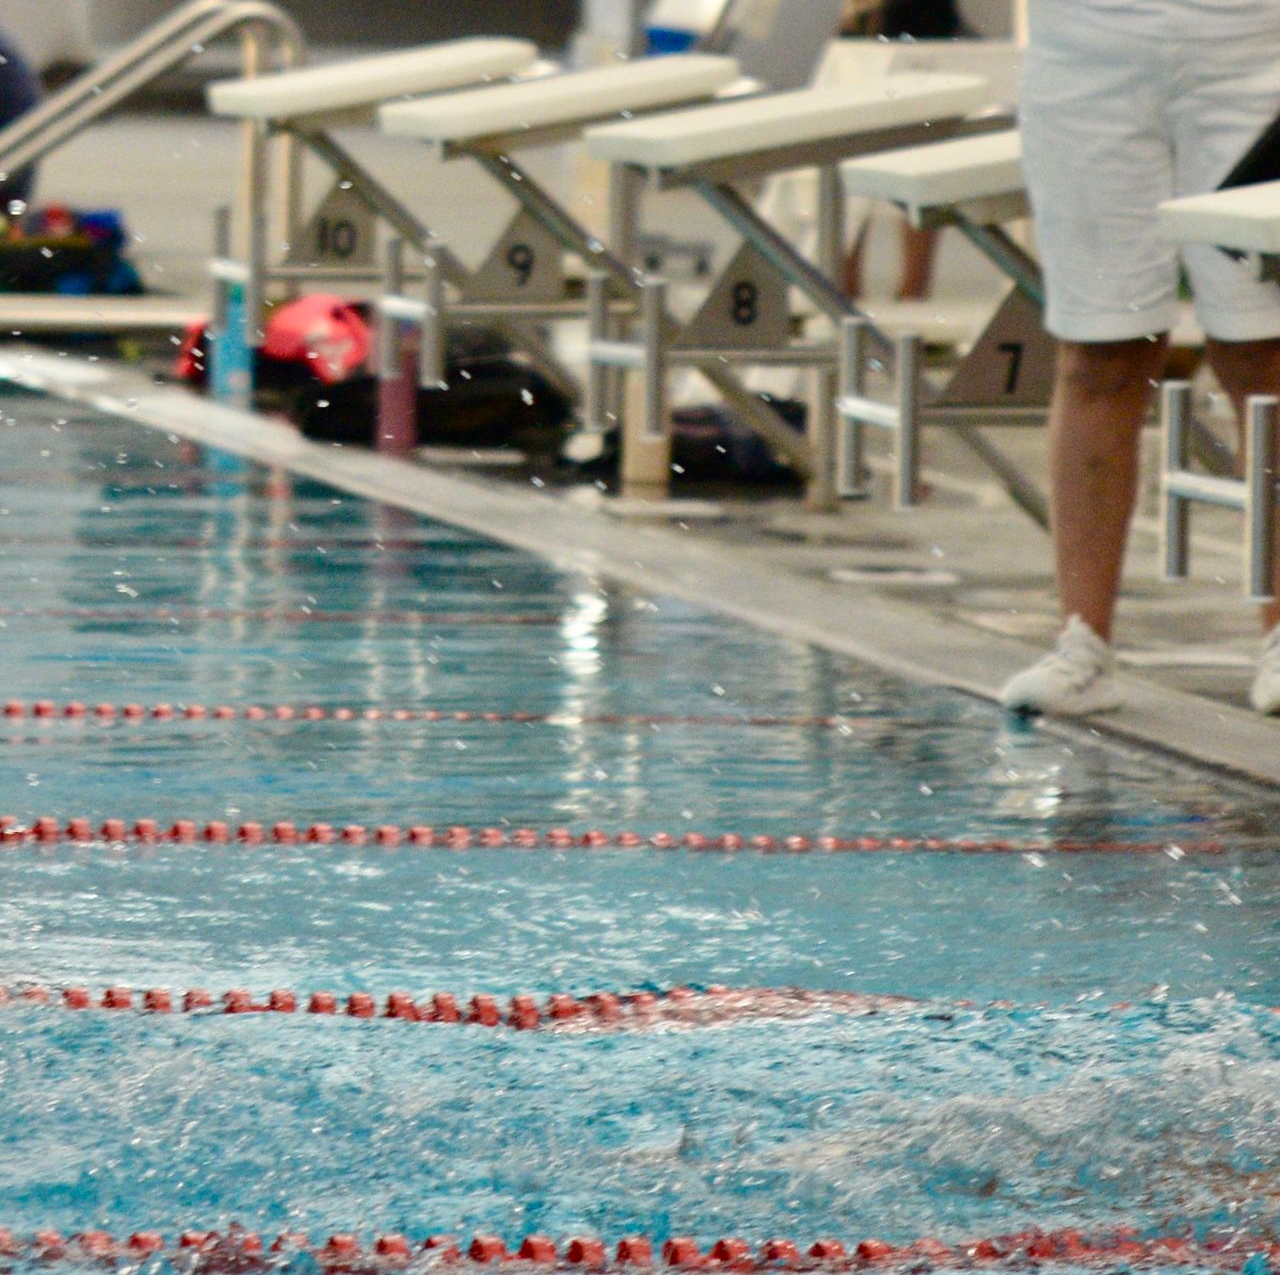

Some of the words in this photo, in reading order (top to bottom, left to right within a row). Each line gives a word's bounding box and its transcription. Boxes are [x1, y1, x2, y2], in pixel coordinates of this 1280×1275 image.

[317, 218, 356, 257] 10
[507, 243, 534, 286] 9
[731, 281, 758, 325] 8
[998, 342, 1024, 394] 7
